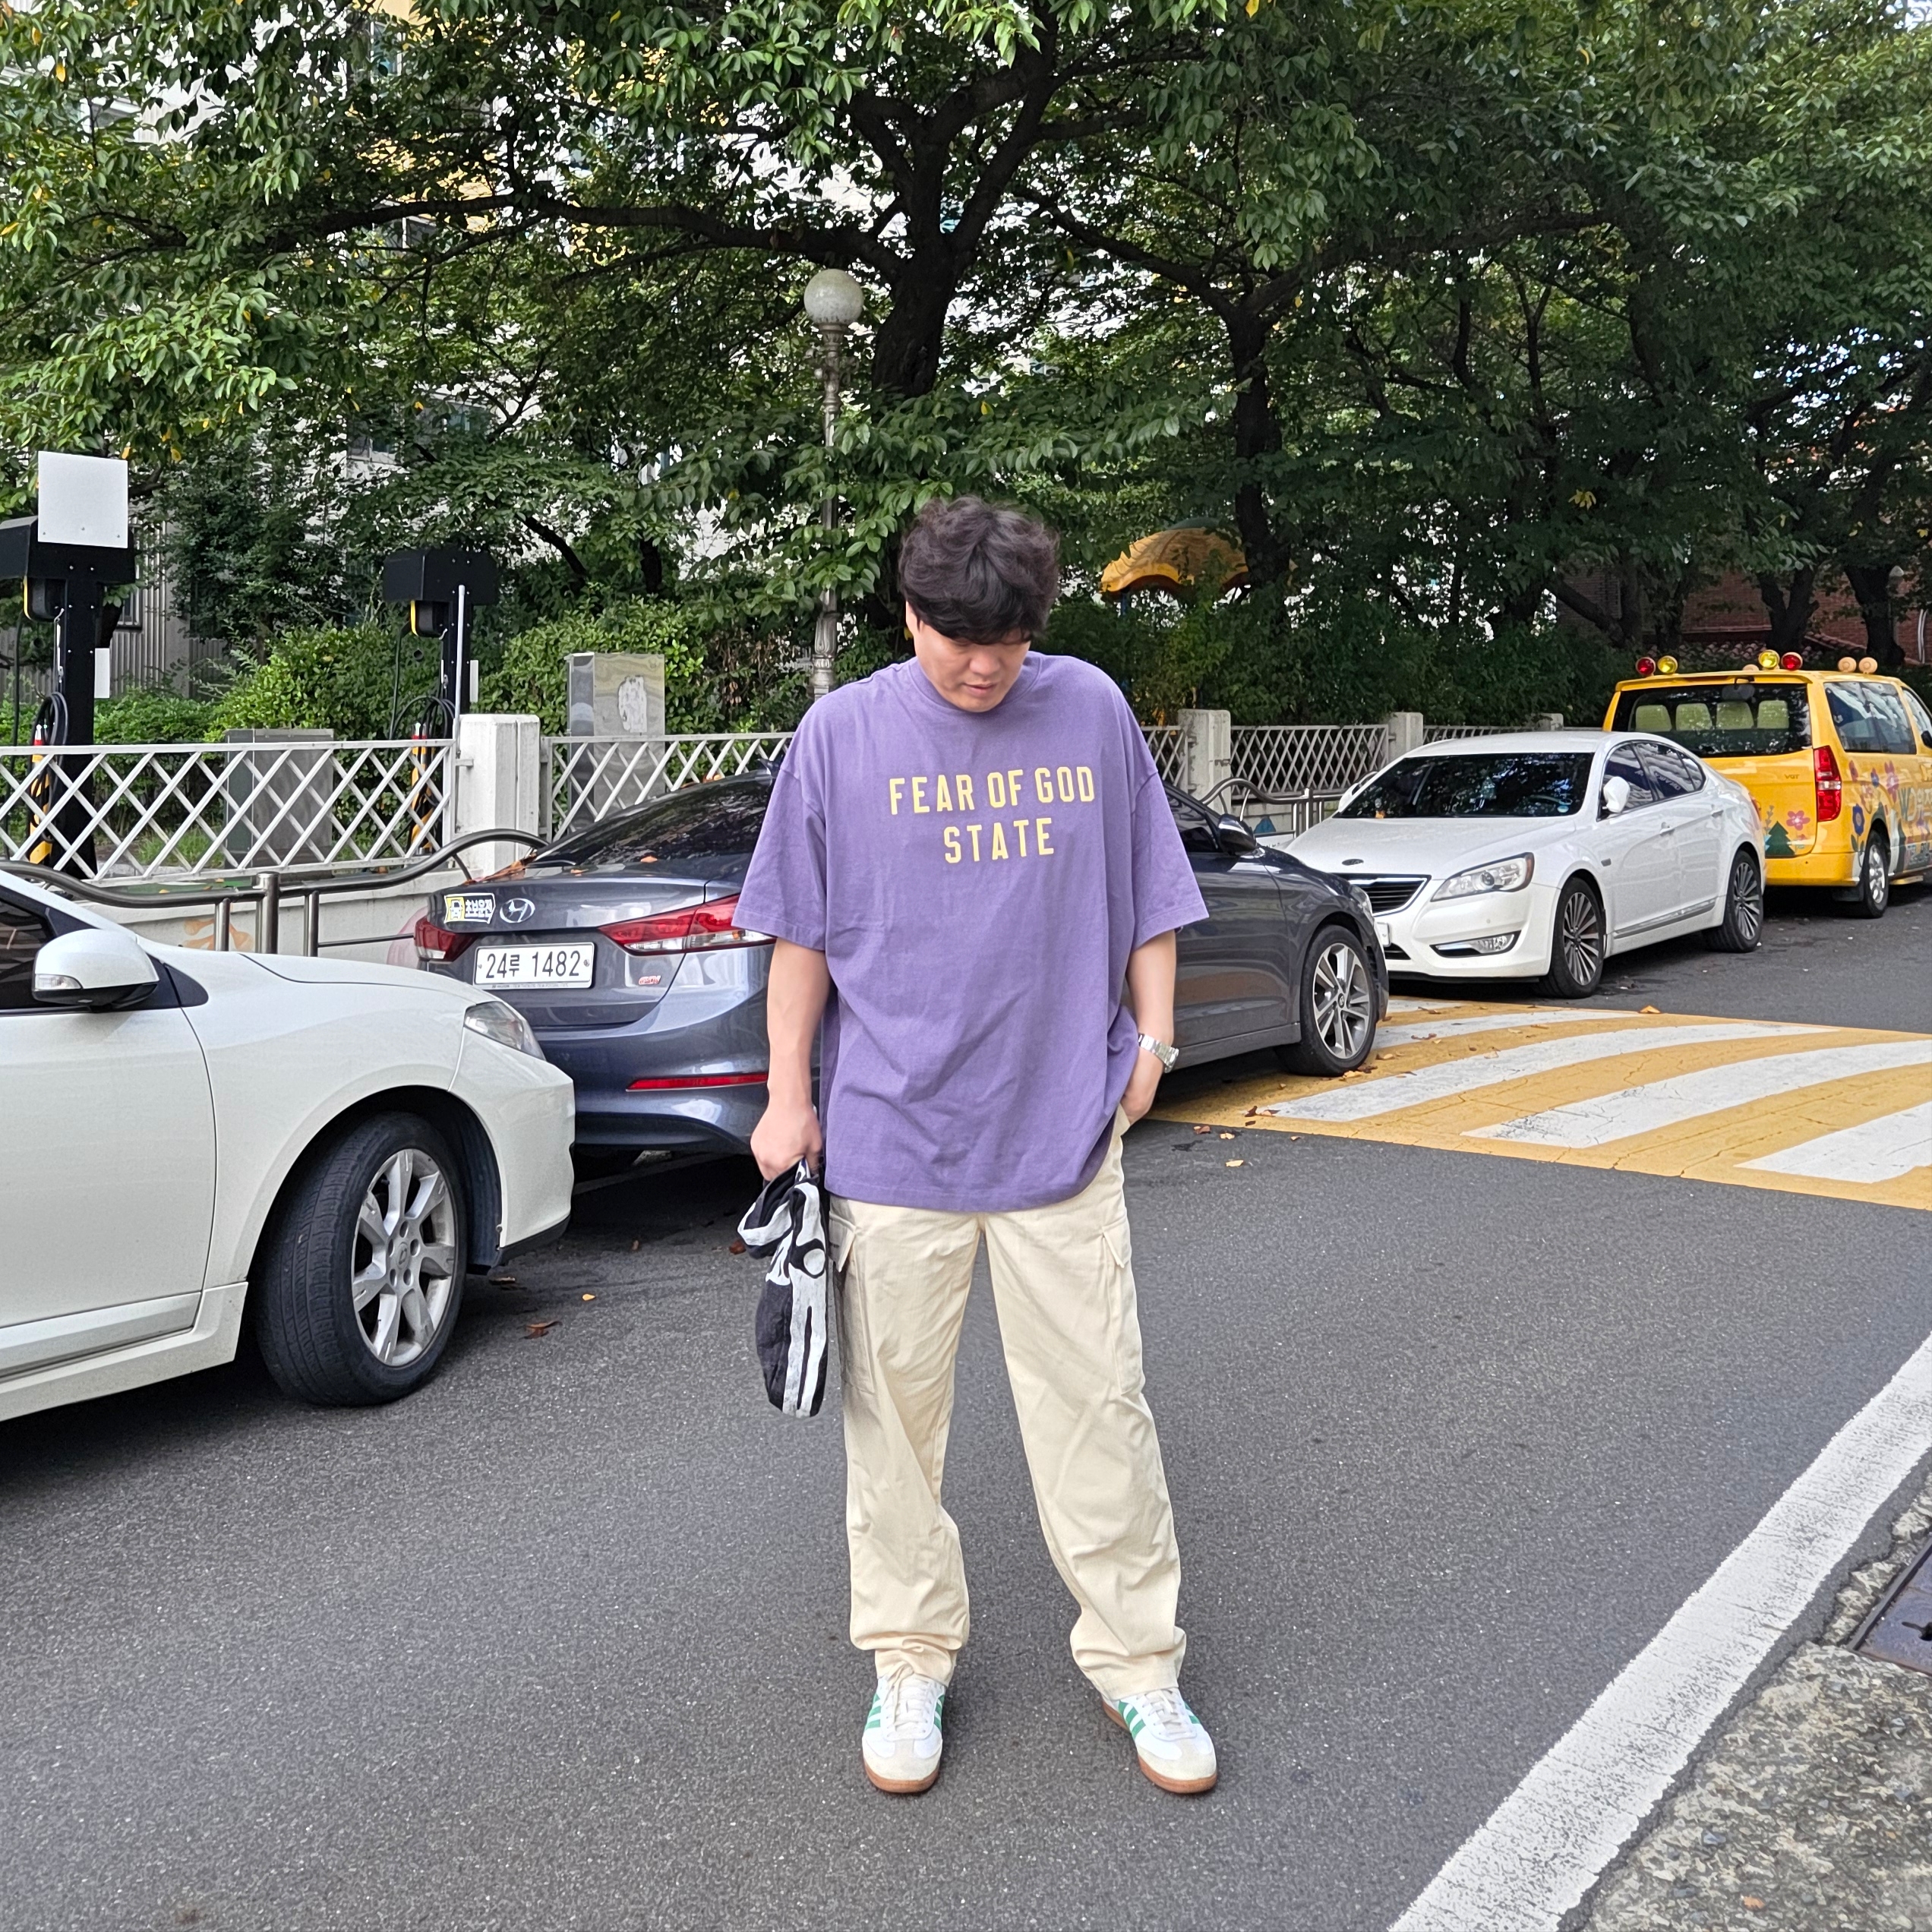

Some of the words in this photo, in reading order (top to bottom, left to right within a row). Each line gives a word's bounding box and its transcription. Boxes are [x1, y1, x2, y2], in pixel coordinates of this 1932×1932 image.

[889, 774, 975, 815] FEAR
[987, 769, 1024, 808] OF
[1034, 766, 1095, 803] GOD
[943, 817, 1054, 863] STATE
[485, 952, 520, 979] 24루
[532, 950, 581, 977] 1482
